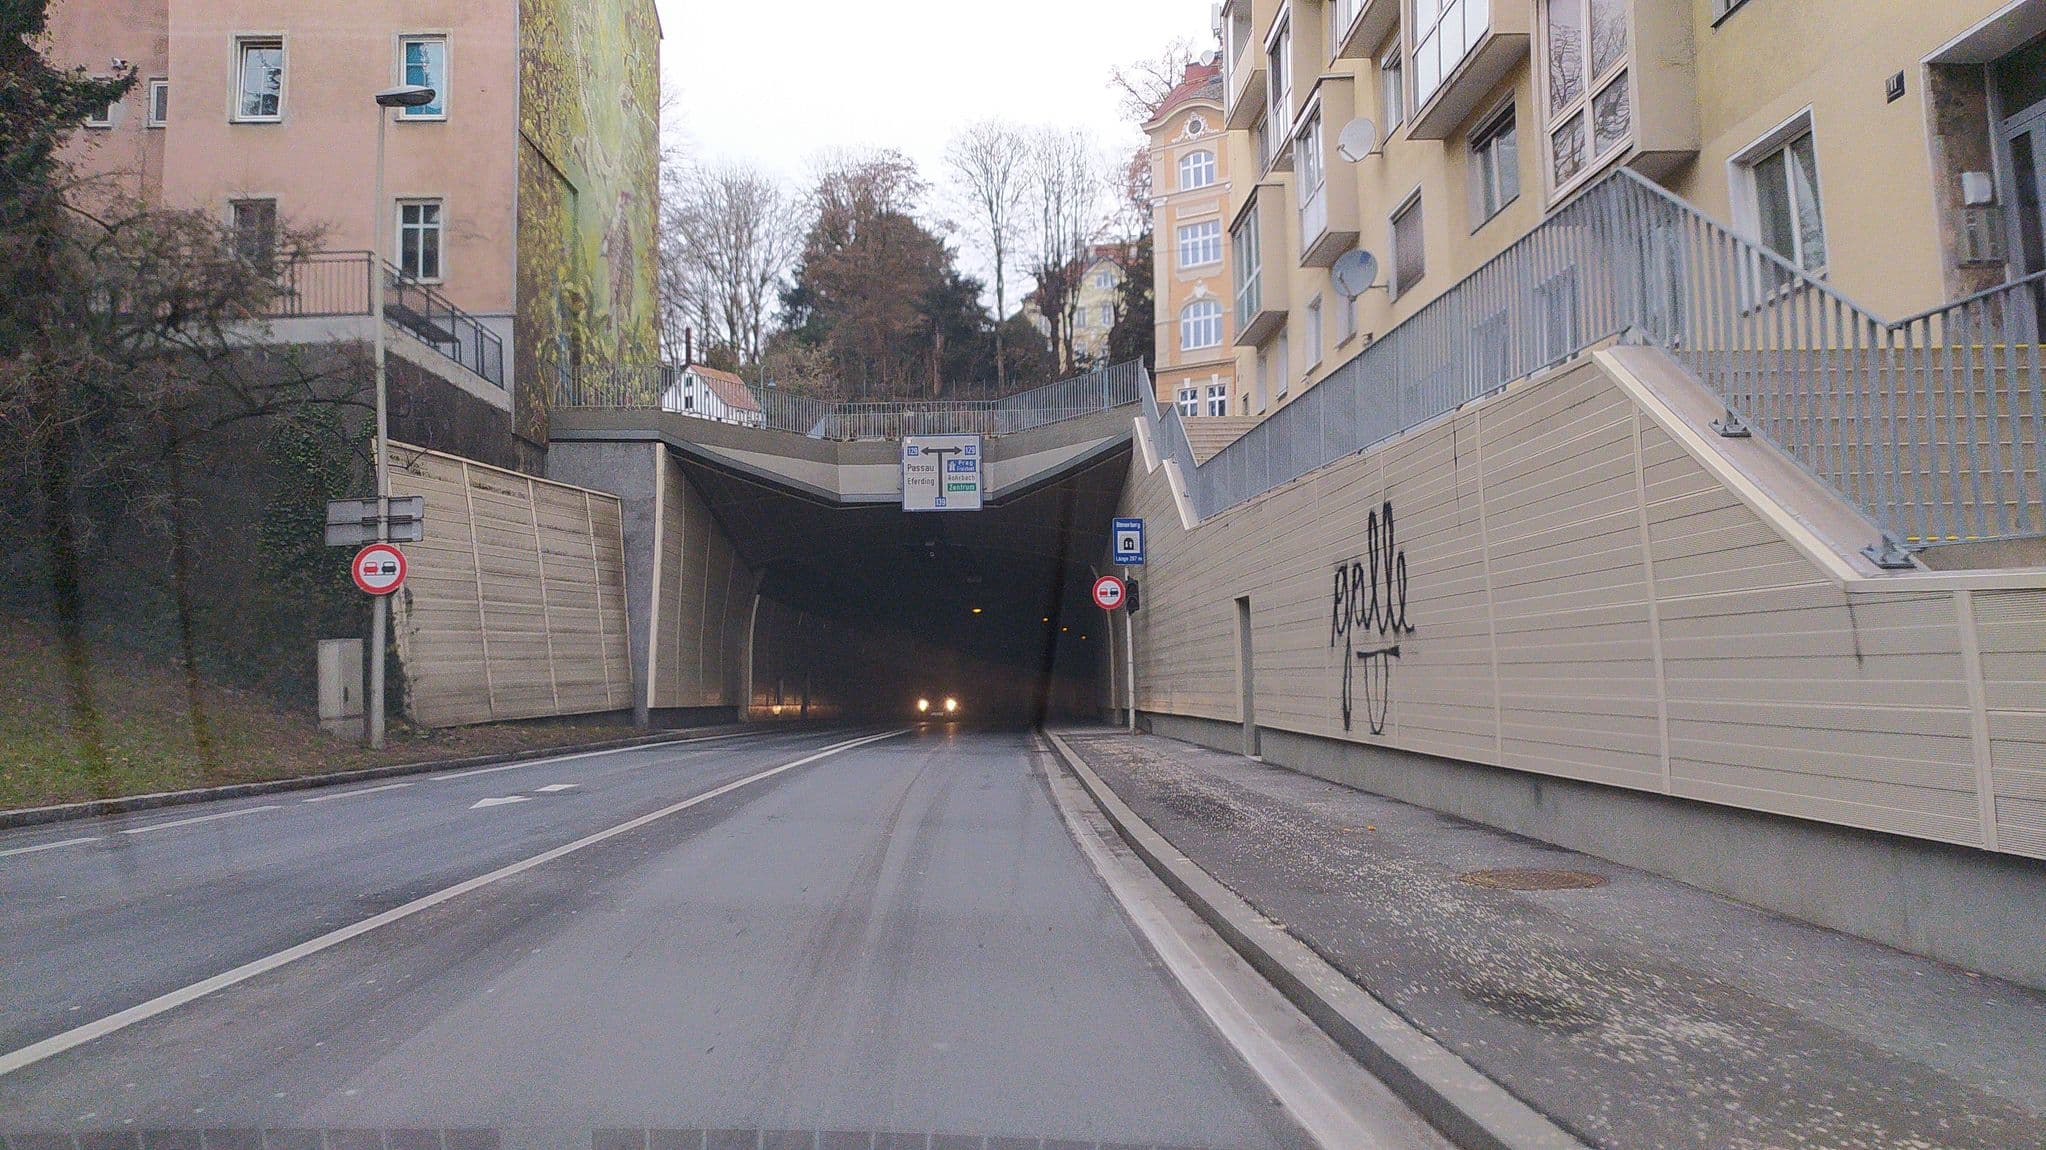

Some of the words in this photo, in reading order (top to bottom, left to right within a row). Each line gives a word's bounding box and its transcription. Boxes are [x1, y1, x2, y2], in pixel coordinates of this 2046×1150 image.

[908, 447, 918, 455] 129
[965, 446, 976, 454] 129
[907, 463, 935, 472] Passau
[907, 477, 935, 487] Eferding
